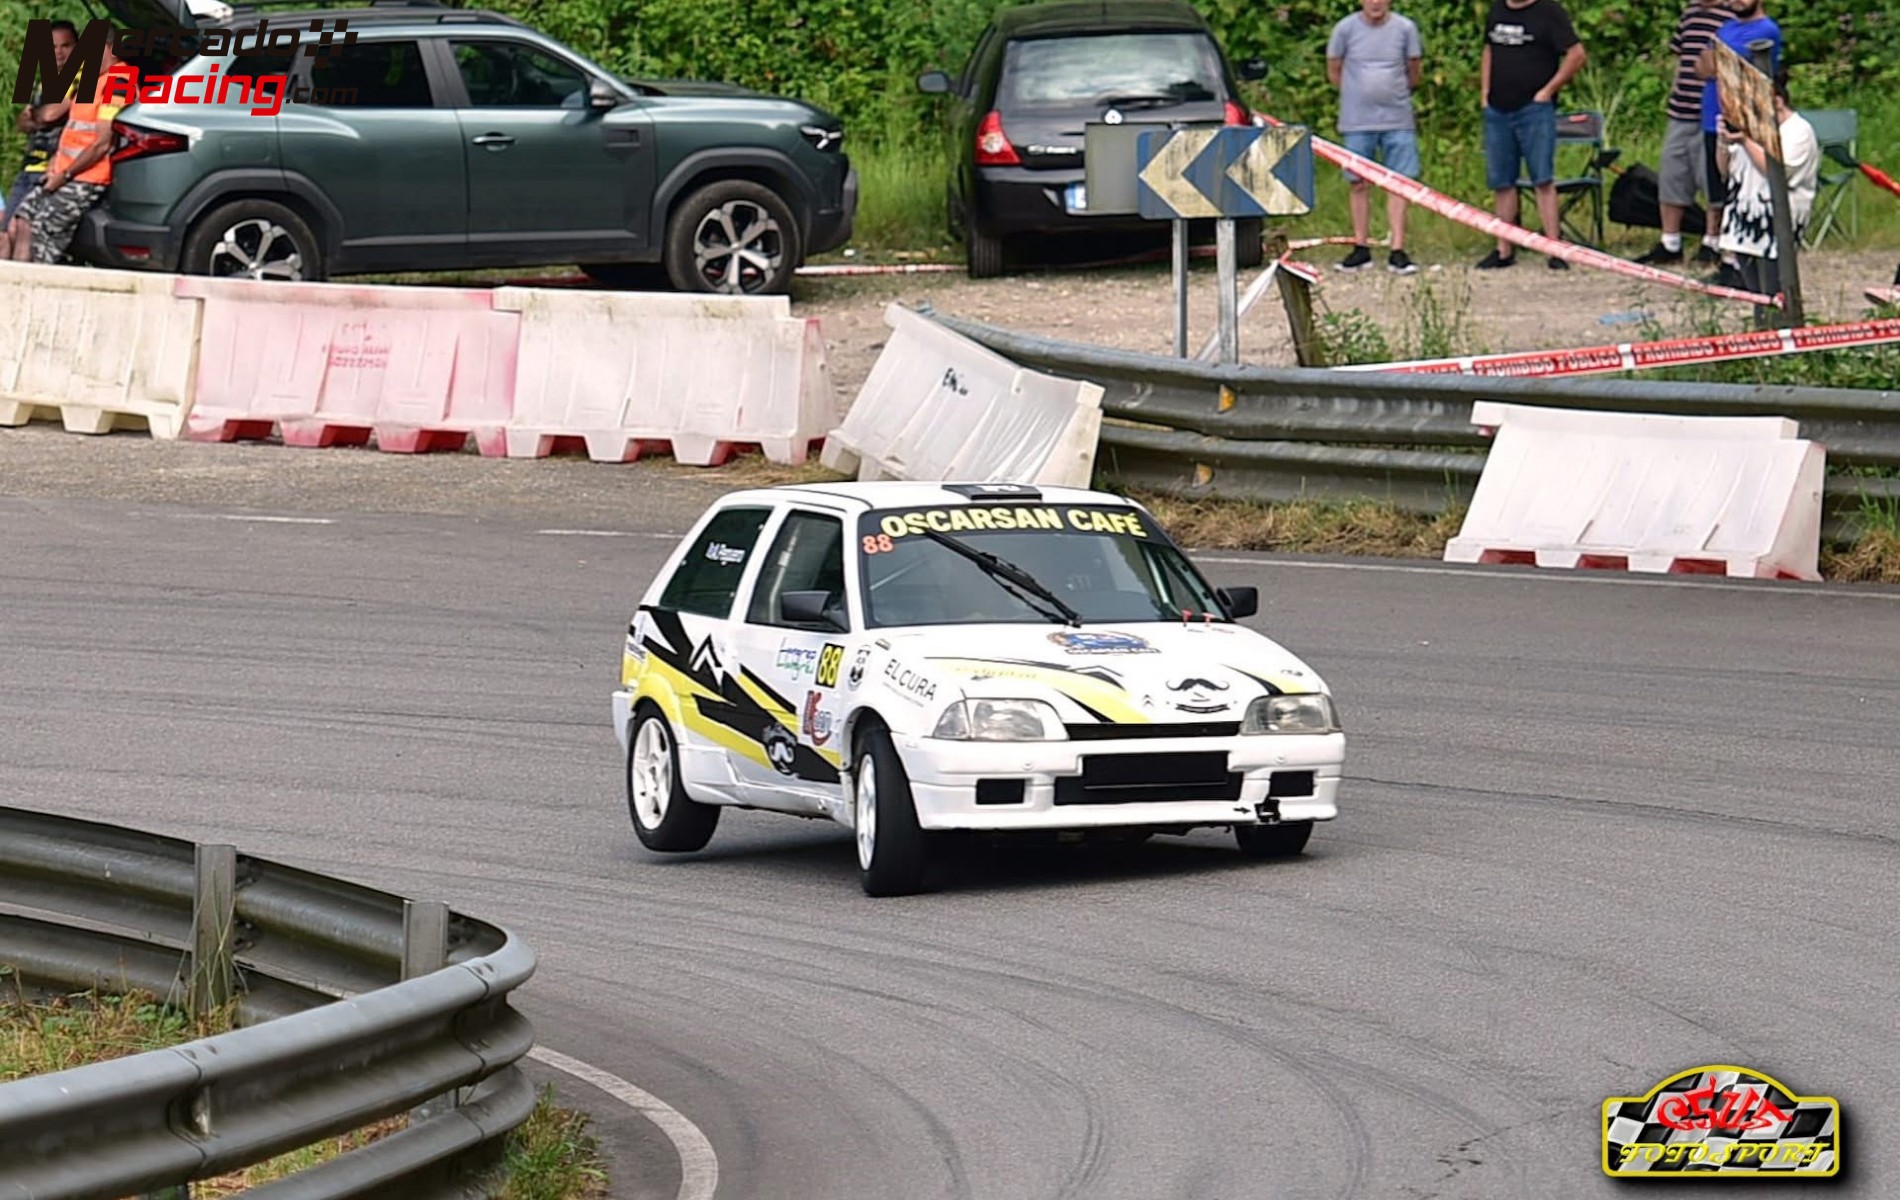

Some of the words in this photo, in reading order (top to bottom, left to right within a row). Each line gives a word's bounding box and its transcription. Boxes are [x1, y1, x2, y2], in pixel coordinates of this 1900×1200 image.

[880, 508, 1064, 537] OSCARSAN
[1067, 508, 1148, 537] CAFÉ
[863, 534, 893, 554] 88
[818, 645, 843, 685] 88
